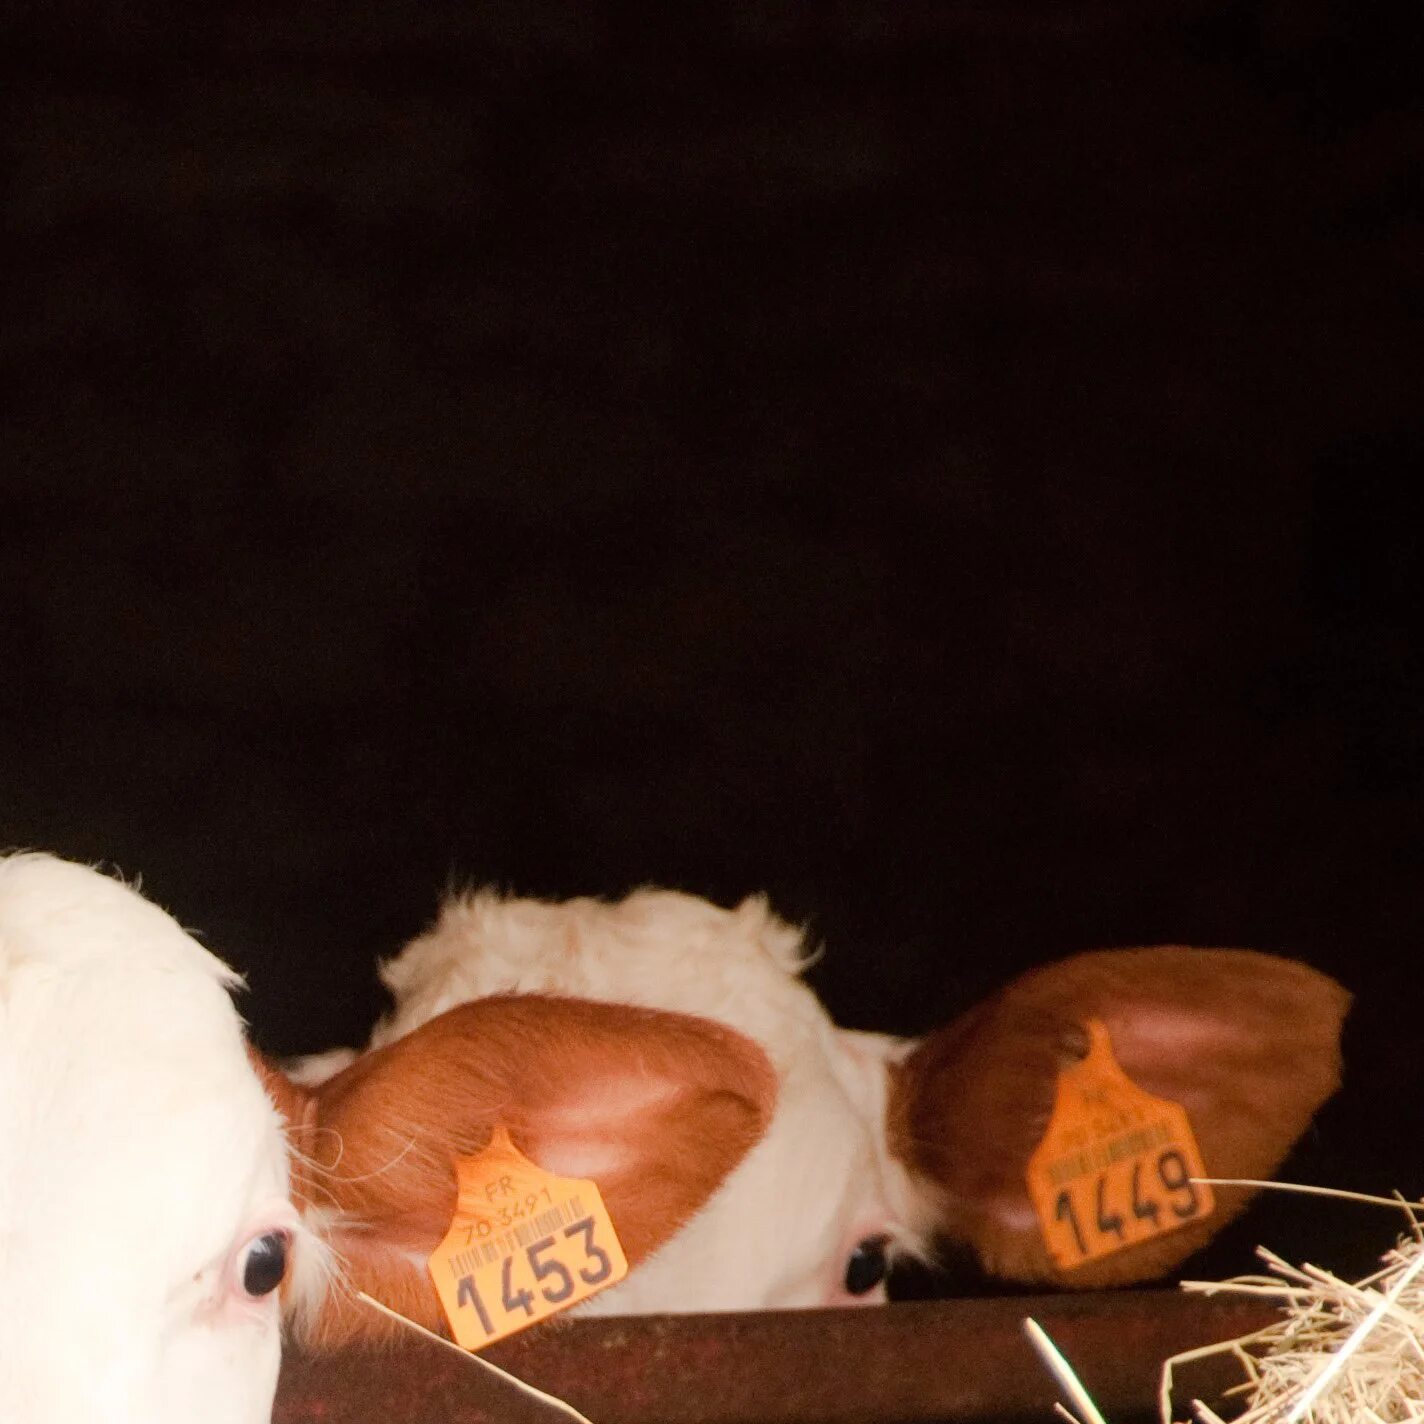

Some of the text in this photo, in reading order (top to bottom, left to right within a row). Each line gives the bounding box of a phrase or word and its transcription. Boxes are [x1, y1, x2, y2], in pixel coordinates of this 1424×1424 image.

[485, 1175, 514, 1202] FR
[1056, 1152, 1197, 1254] 1449
[462, 1220, 492, 1245] 70
[457, 1216, 612, 1336] 1453
